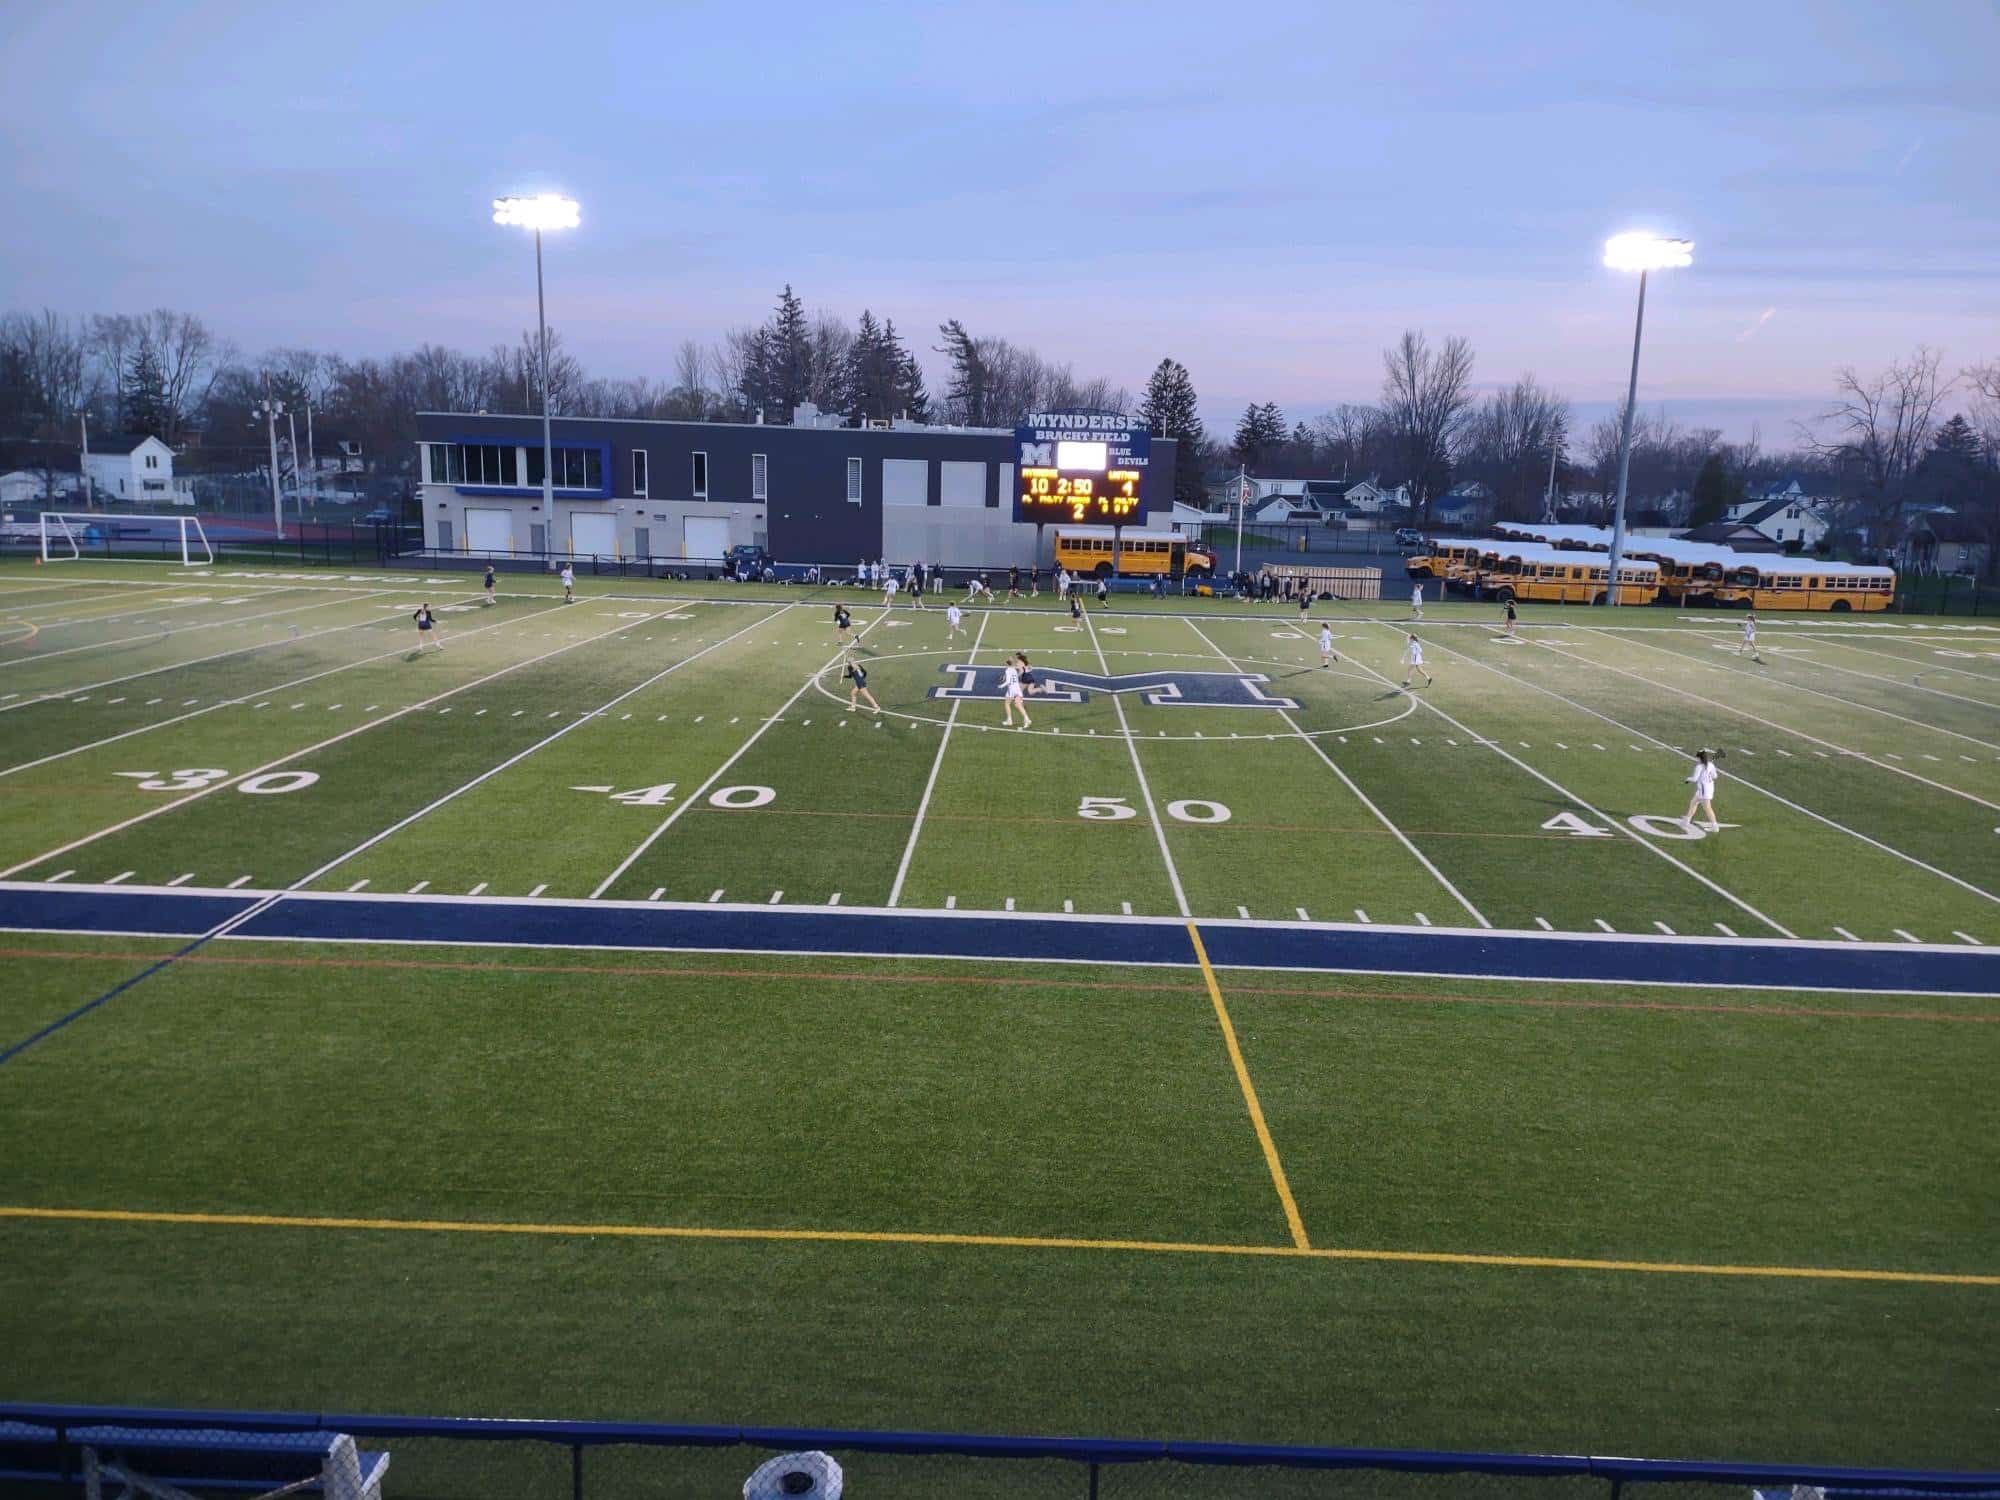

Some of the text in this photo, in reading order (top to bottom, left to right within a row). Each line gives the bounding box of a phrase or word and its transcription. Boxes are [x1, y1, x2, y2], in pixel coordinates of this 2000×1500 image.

[1028, 414, 1138, 430] MYNDERSE
[1035, 430, 1131, 442] BRACHT FIELD
[1021, 442, 1052, 466] M
[1030, 478, 1049, 494] 10
[1057, 478, 1093, 495] 2:50
[1122, 481, 1133, 496] 4
[1074, 504, 1084, 519] 2
[928, 663, 1304, 710] M
[137, 768, 321, 794] 30
[608, 782, 777, 809] 40
[1077, 796, 1232, 823] 50
[1540, 811, 1707, 840] 40
